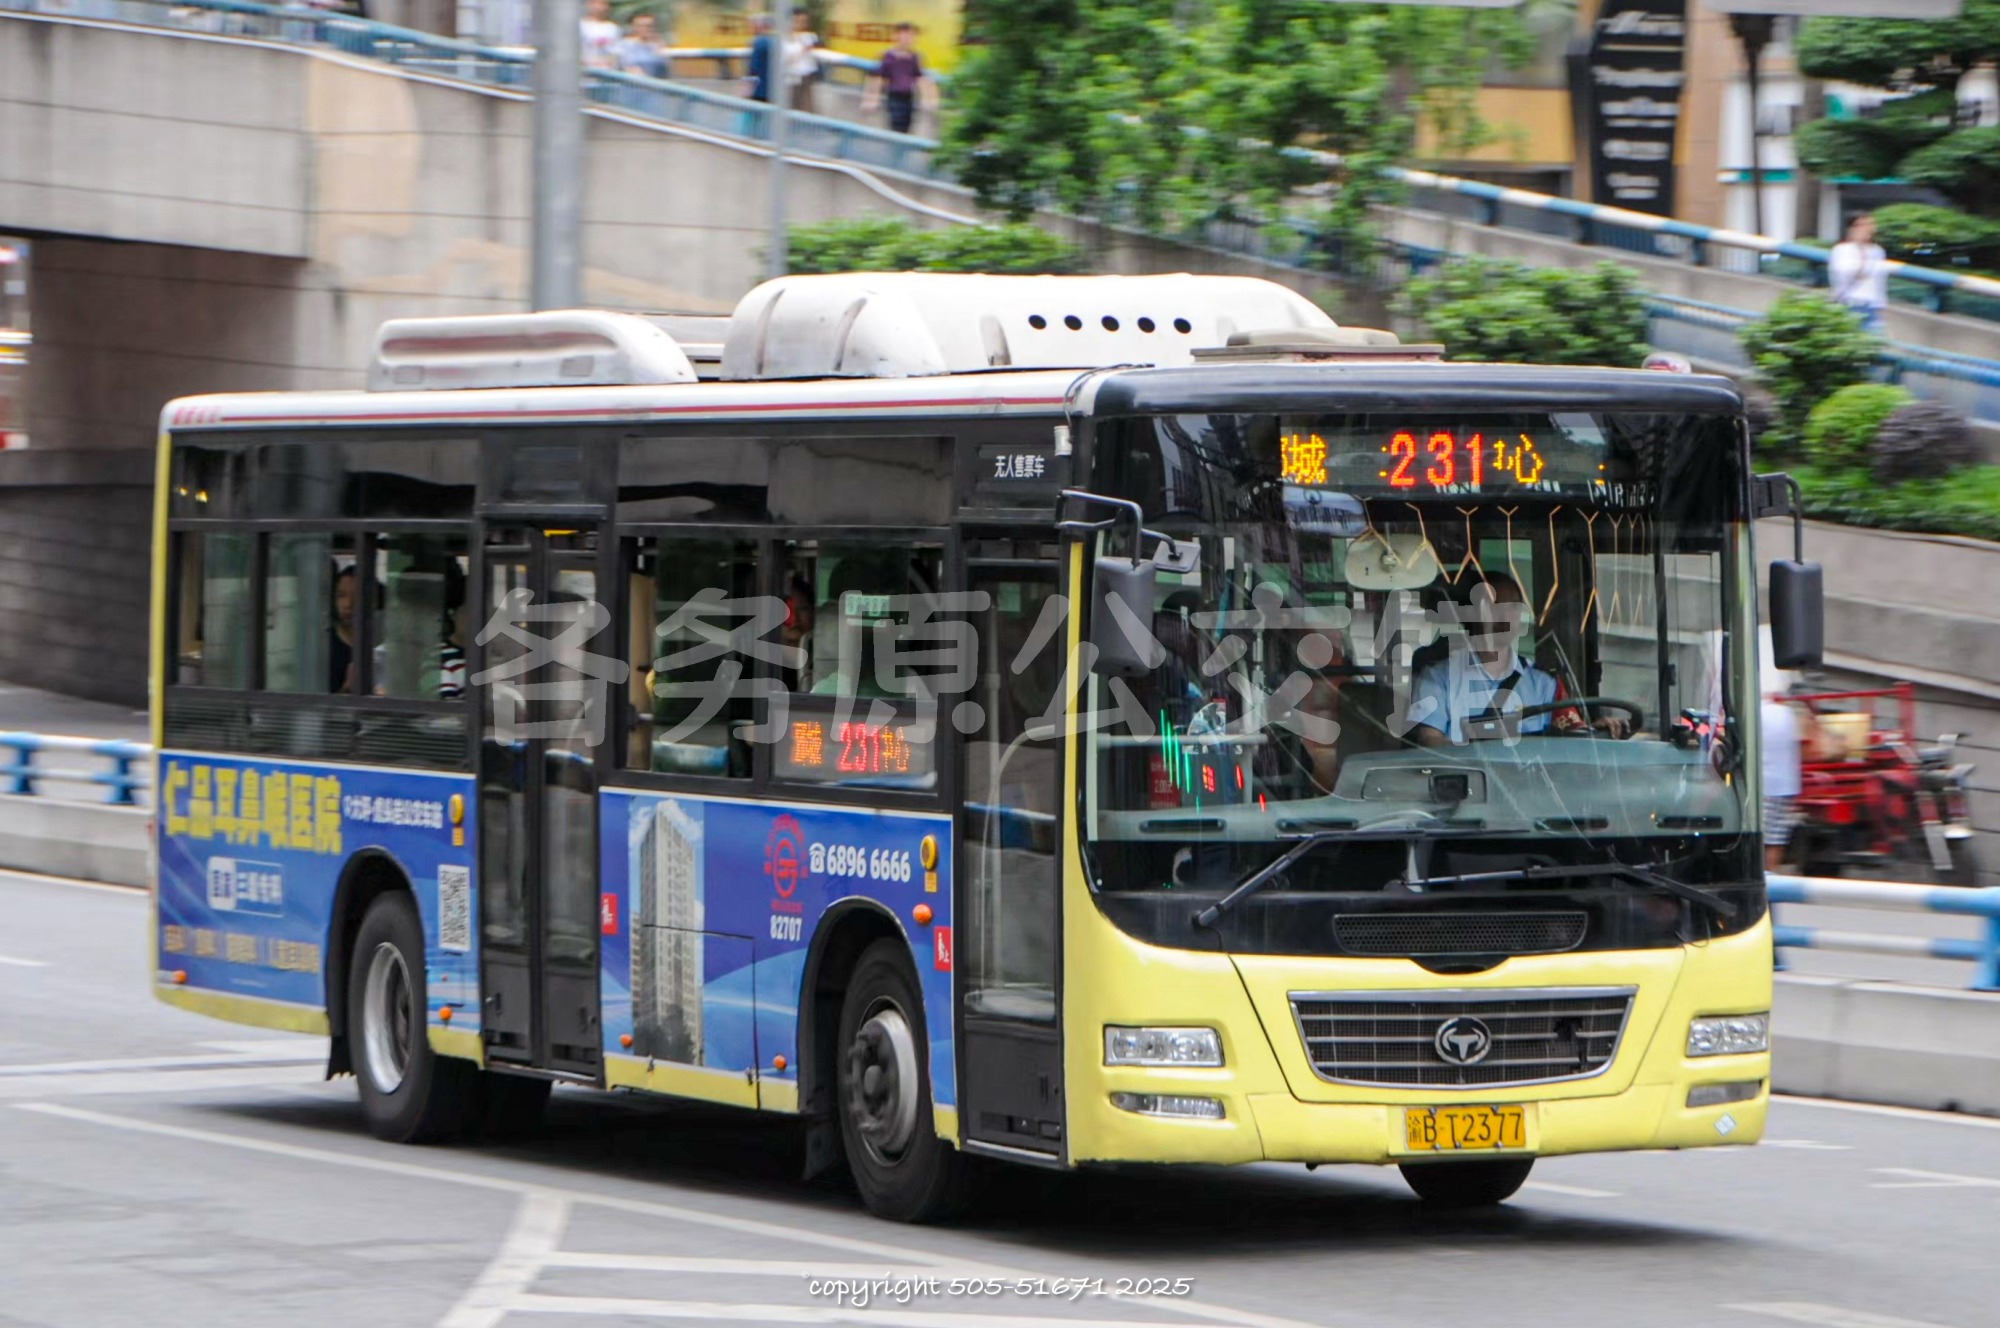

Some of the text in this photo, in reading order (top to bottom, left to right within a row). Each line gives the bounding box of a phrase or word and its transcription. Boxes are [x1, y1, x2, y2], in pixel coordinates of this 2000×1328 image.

[994, 454, 1045, 478] 无人售票车
[1390, 432, 1484, 487] 231
[838, 722, 880, 772] 231
[827, 845, 867, 878] 6896
[870, 849, 911, 883] 6666
[770, 915, 803, 941] 82707
